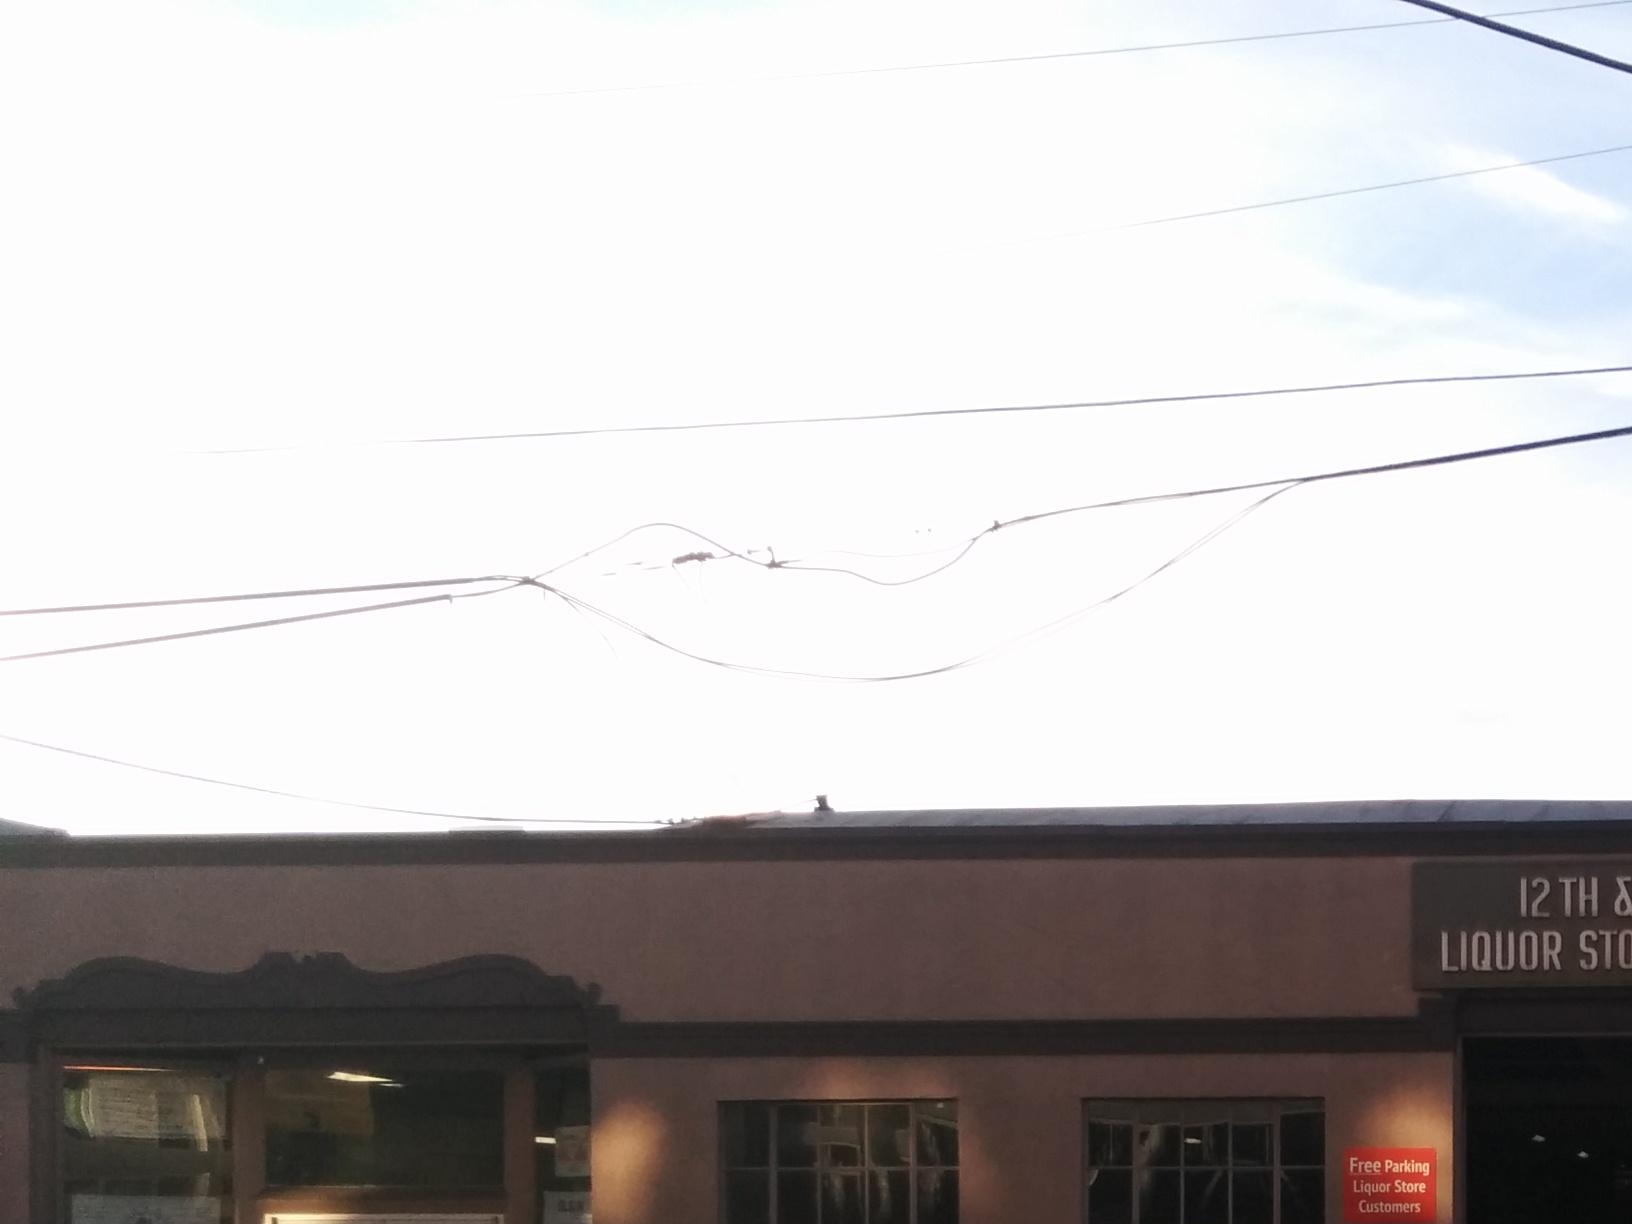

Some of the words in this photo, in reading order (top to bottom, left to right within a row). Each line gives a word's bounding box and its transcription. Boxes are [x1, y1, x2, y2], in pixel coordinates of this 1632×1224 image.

[1441, 931, 1563, 973] LIQUOR
[1349, 1157, 1381, 1174] Free
[1384, 1159, 1430, 1176] Parking
[1353, 1180, 1391, 1196] Liquor
[1394, 1180, 1426, 1193] Store
[1358, 1200, 1421, 1213] Customers
